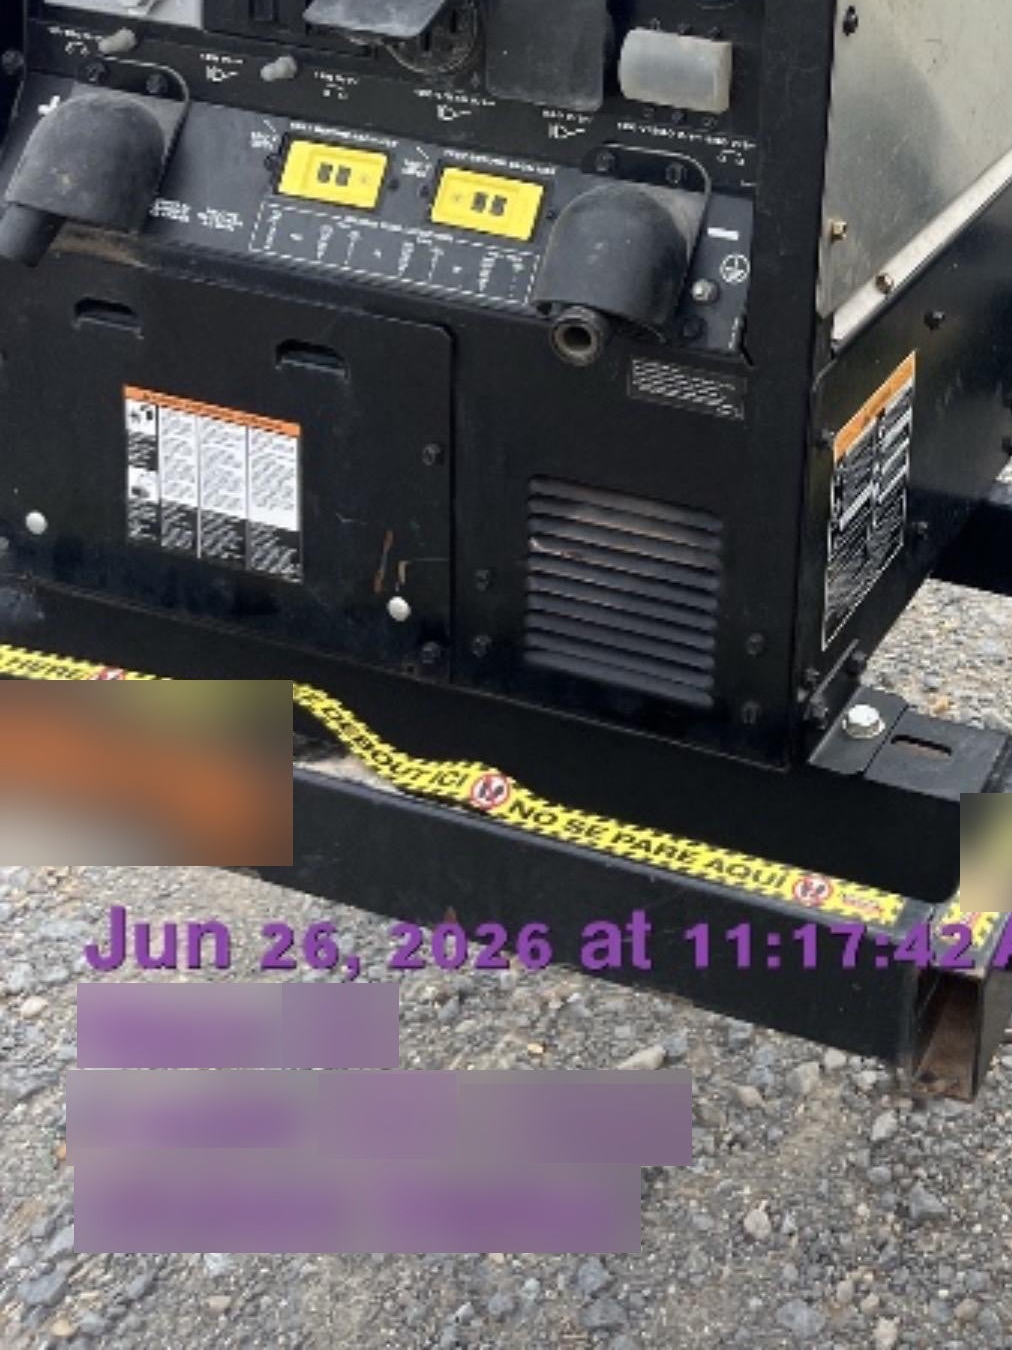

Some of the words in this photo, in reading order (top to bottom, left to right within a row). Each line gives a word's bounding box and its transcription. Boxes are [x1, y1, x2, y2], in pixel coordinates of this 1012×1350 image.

[508, 801, 559, 826] NO
[565, 818, 609, 839] SE
[612, 831, 698, 865] PARE
